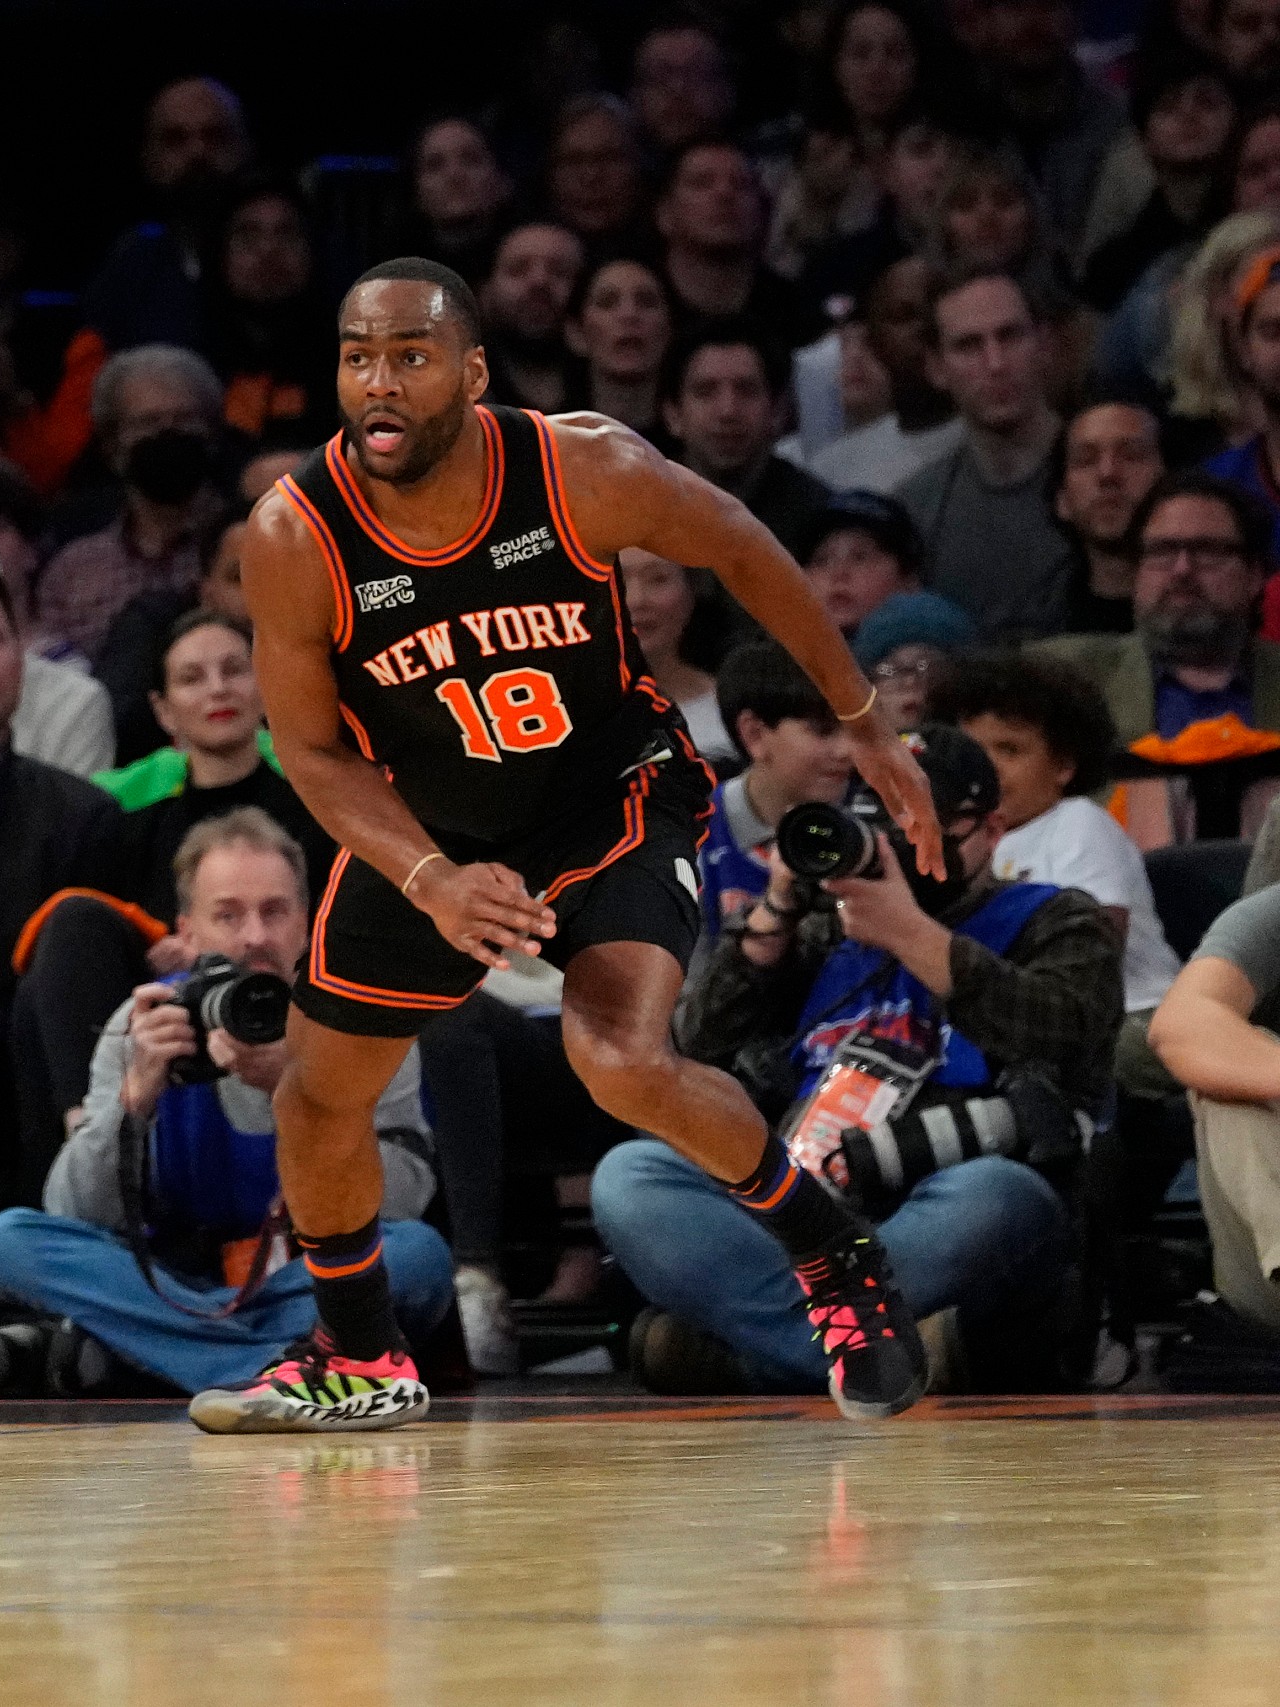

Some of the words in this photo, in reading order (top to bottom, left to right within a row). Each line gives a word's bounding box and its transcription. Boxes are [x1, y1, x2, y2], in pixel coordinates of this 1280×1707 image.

[489, 526, 550, 558] SQUARE
[493, 542, 542, 570] SPACE
[362, 619, 458, 687] NEW
[460, 601, 593, 657] YORK
[434, 666, 574, 764] 18
